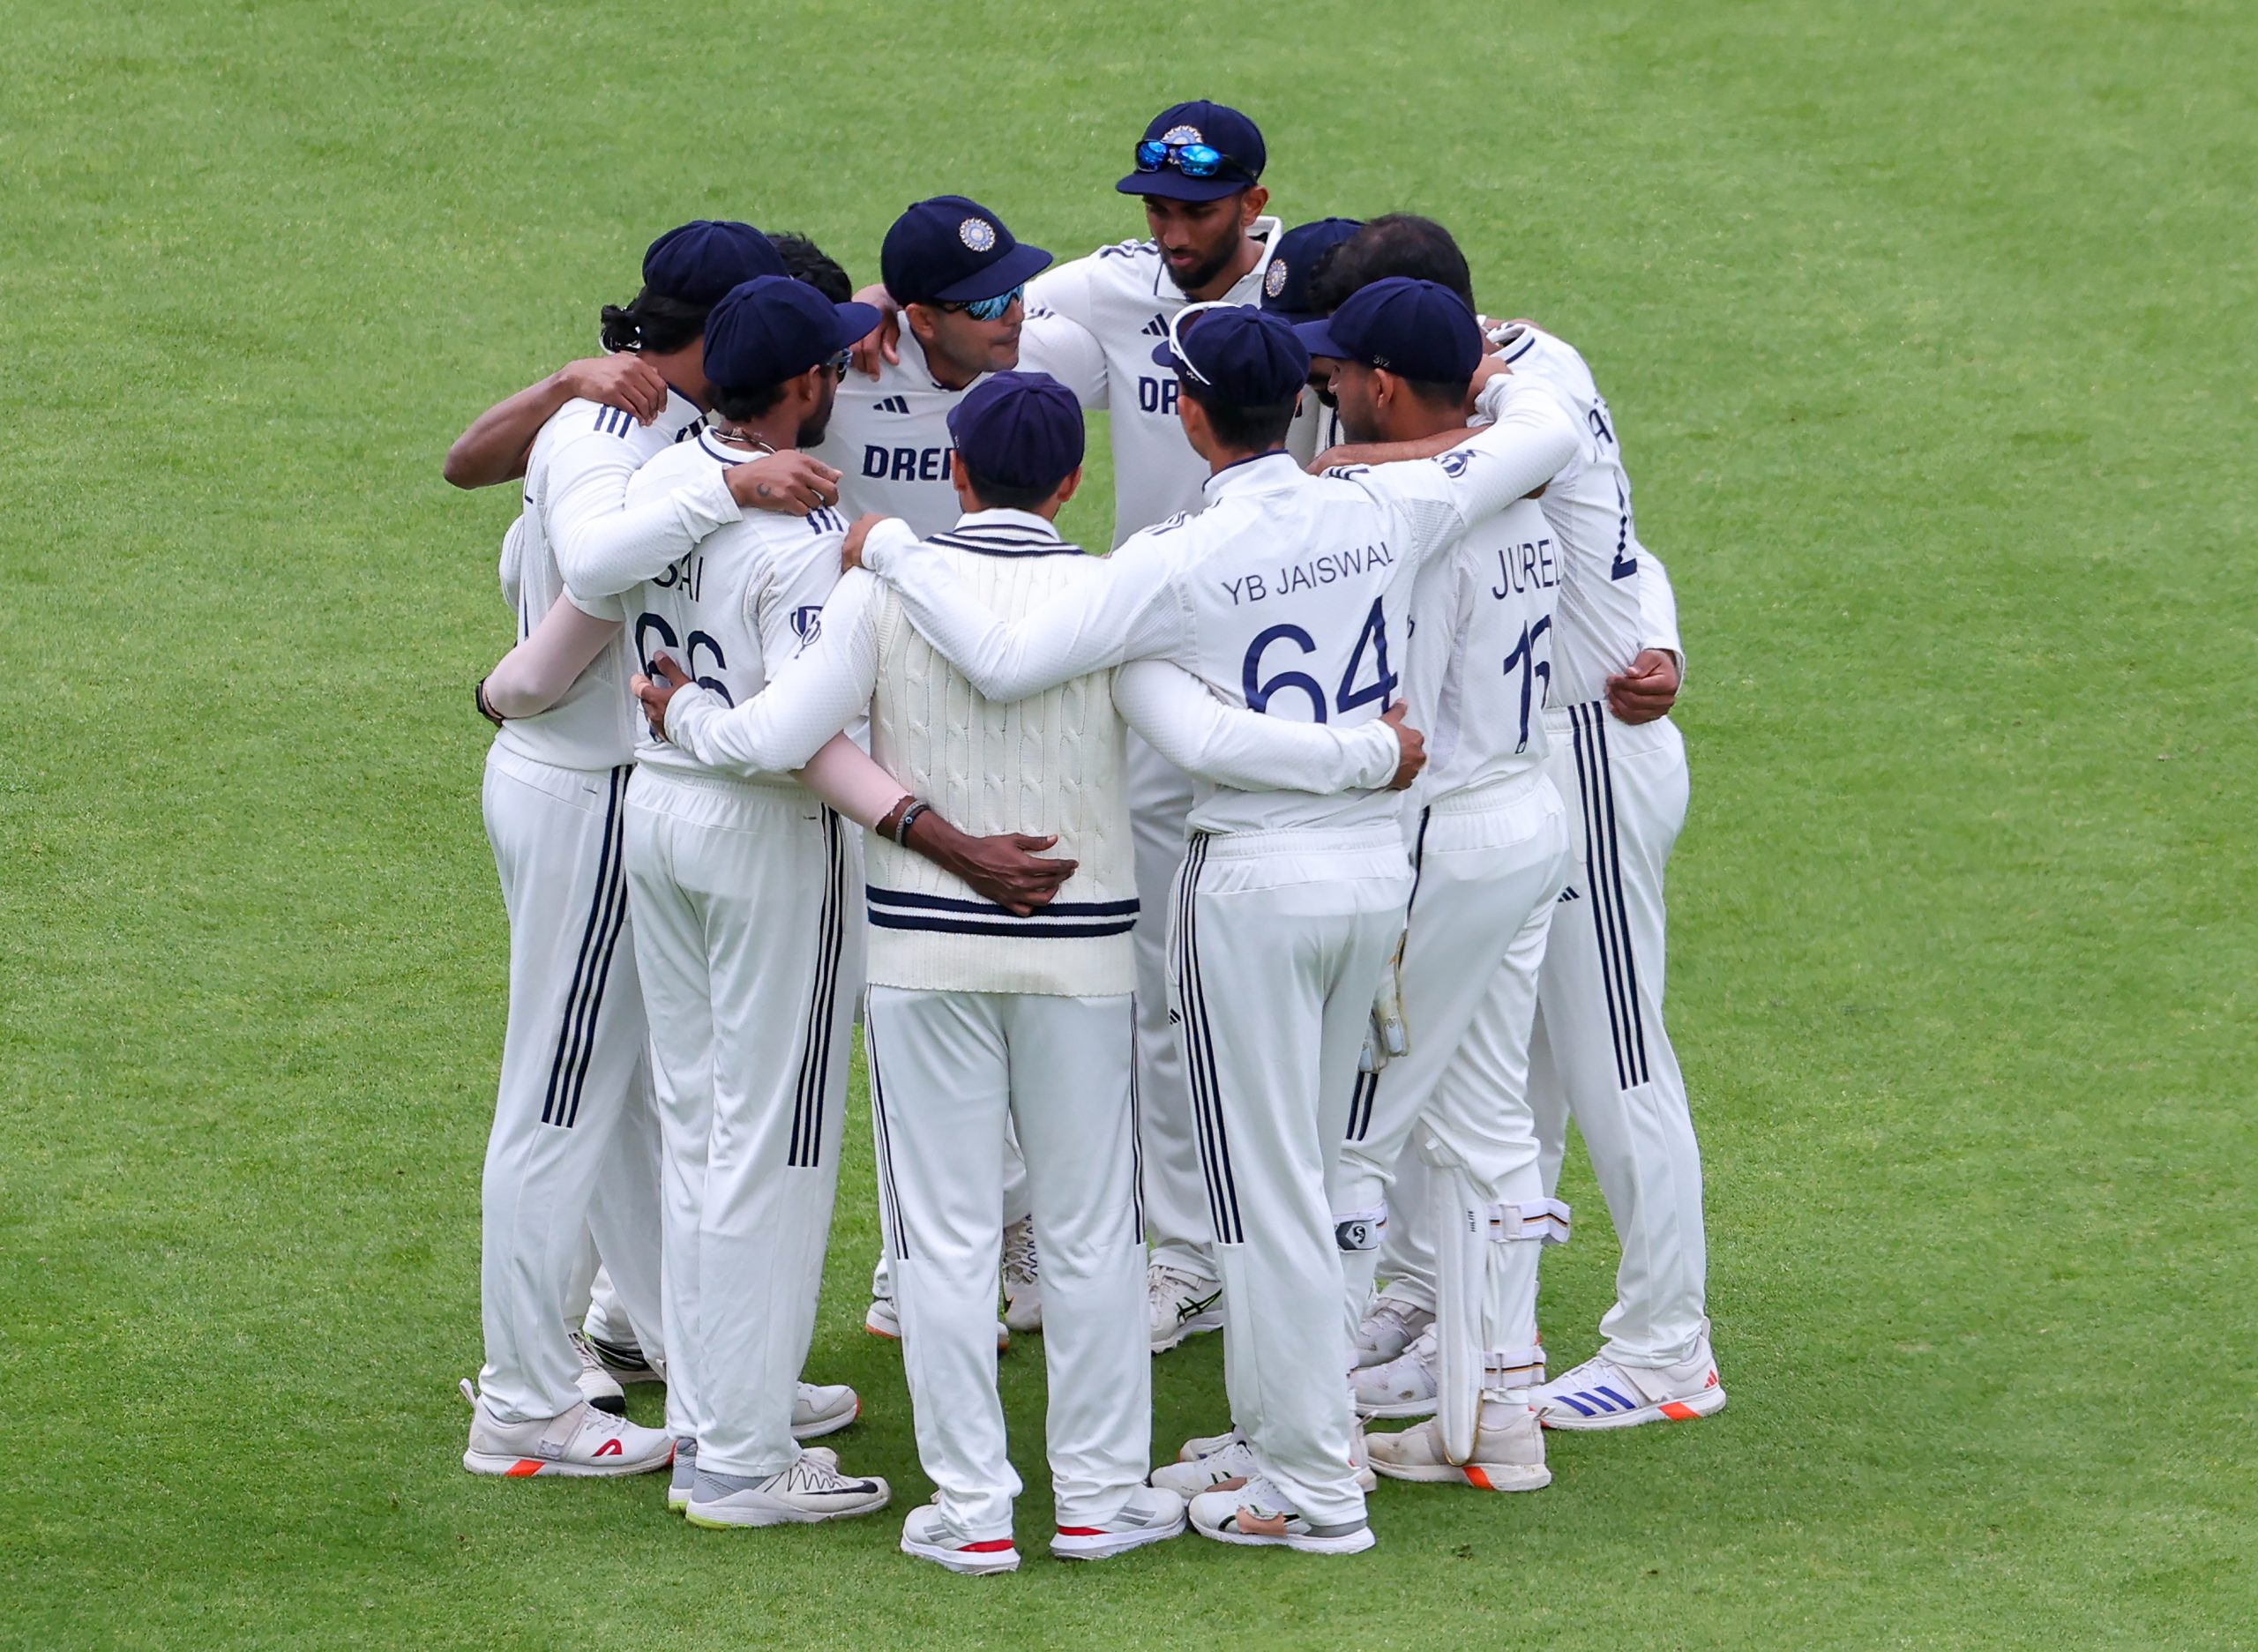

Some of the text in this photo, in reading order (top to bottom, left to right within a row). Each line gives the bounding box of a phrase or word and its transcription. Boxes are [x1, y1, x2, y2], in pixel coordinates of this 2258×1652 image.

[1221, 542, 1394, 606] YB JAISWAL
[1243, 594, 1395, 724] 64
